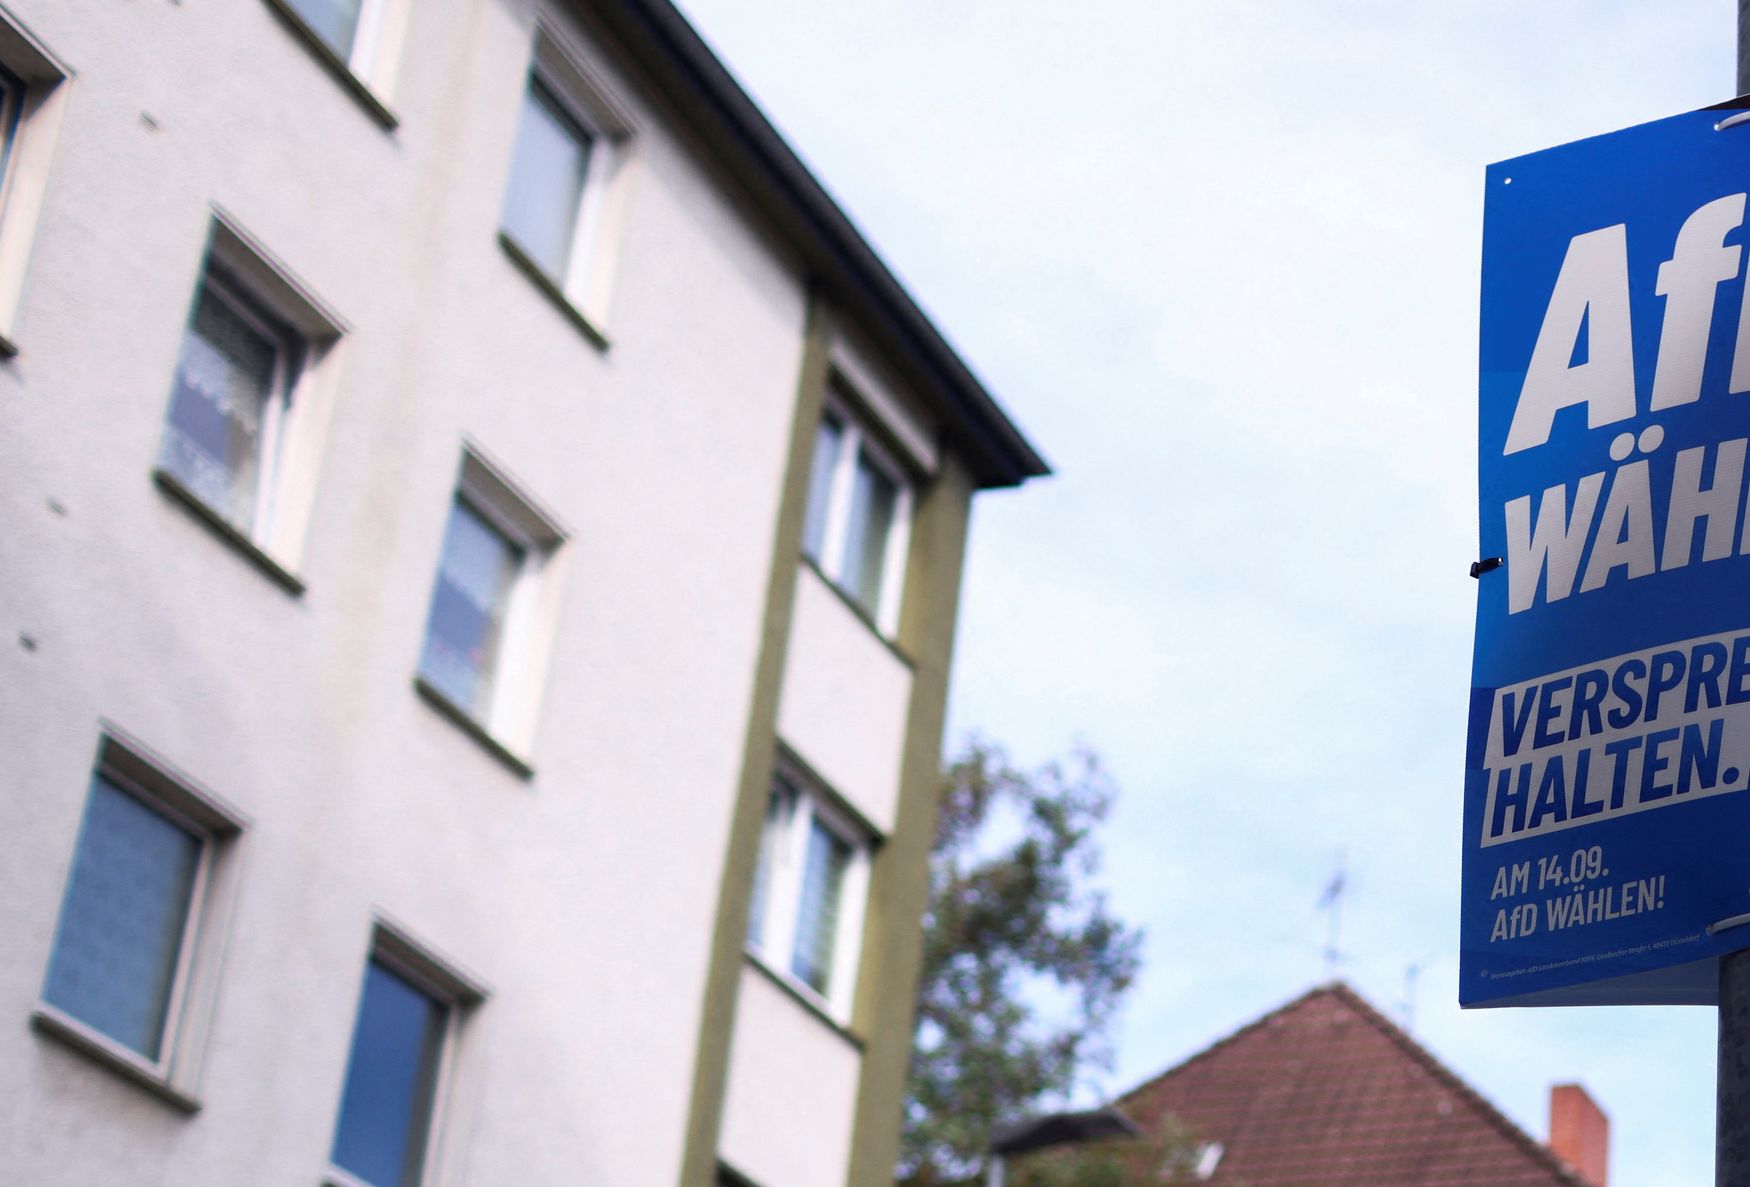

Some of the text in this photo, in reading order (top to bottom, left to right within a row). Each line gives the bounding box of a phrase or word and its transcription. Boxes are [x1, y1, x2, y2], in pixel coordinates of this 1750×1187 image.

[1490, 717, 1740, 838] HALTEN.
[1489, 845, 1610, 900] AM 14.09.
[1489, 874, 1666, 943] AfD WÄHLEN!
